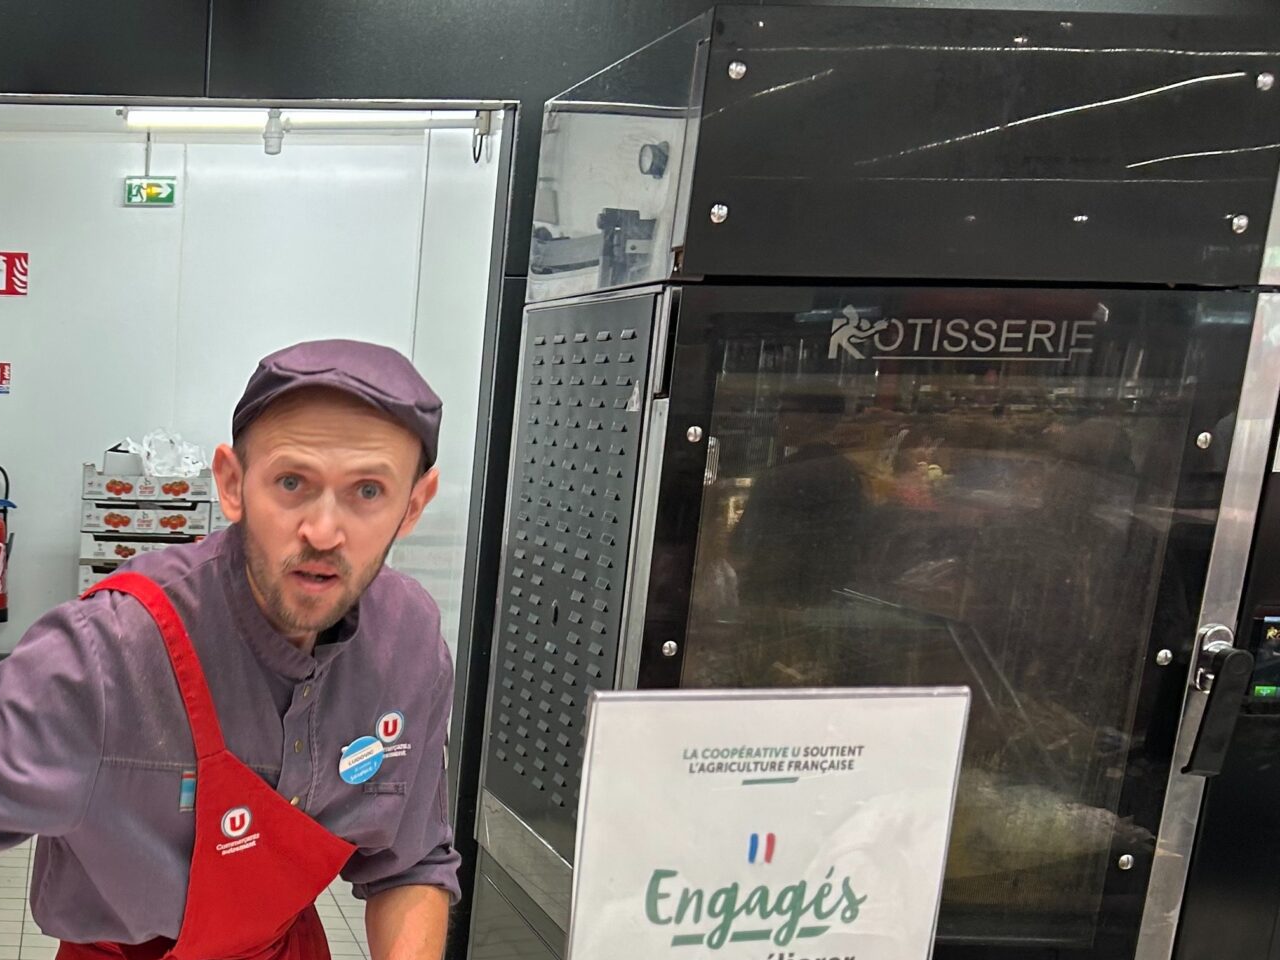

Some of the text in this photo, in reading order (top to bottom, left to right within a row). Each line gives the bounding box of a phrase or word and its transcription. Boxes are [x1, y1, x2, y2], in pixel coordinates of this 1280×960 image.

[383, 719, 398, 737] U
[683, 745, 865, 760] LA COOPÉRATIVE U SOUTIENT
[689, 759, 854, 774] L'AGRICULTURE FRANÇAISE
[230, 813, 246, 832] U
[645, 866, 868, 950] Engagés
